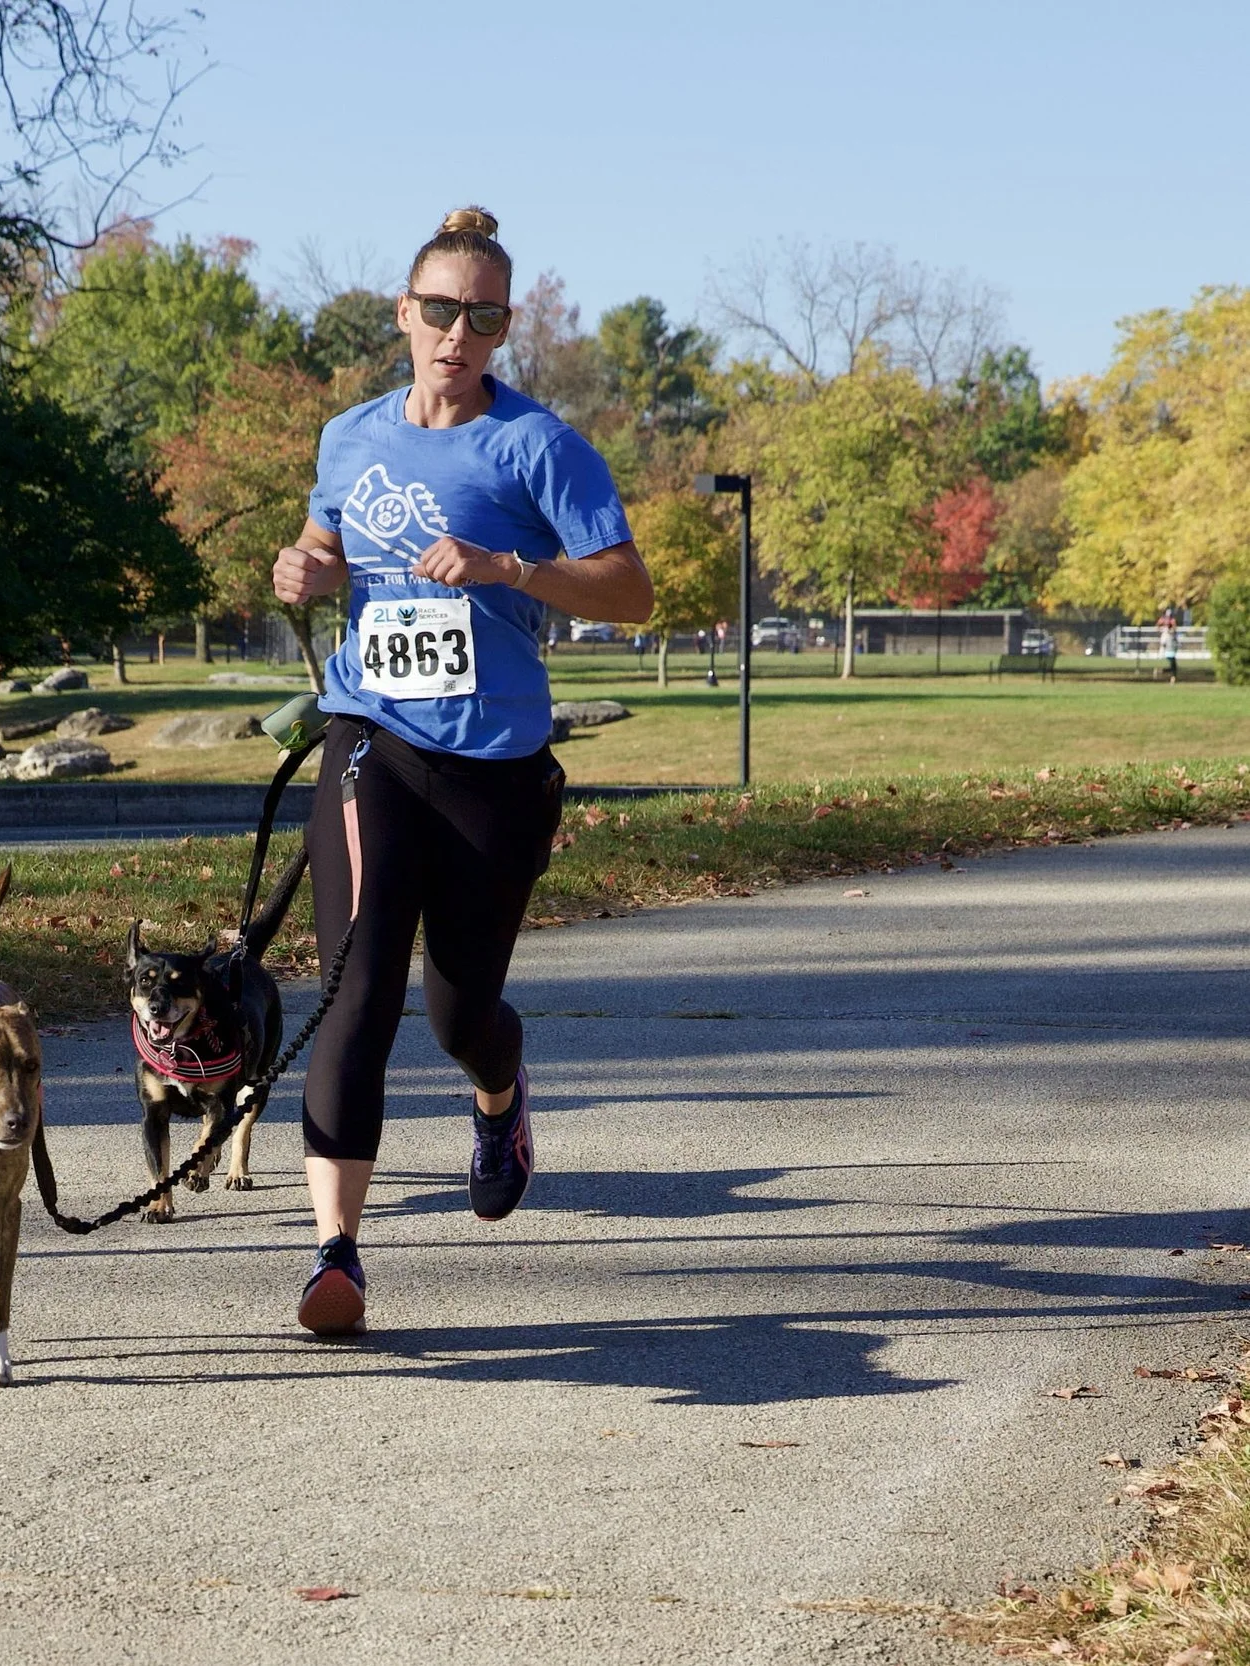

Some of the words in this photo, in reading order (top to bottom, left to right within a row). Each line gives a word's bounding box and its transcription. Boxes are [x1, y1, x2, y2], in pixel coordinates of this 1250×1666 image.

[384, 574, 407, 586] FOR
[373, 608, 398, 623] 2L
[364, 629, 469, 679] 4863
